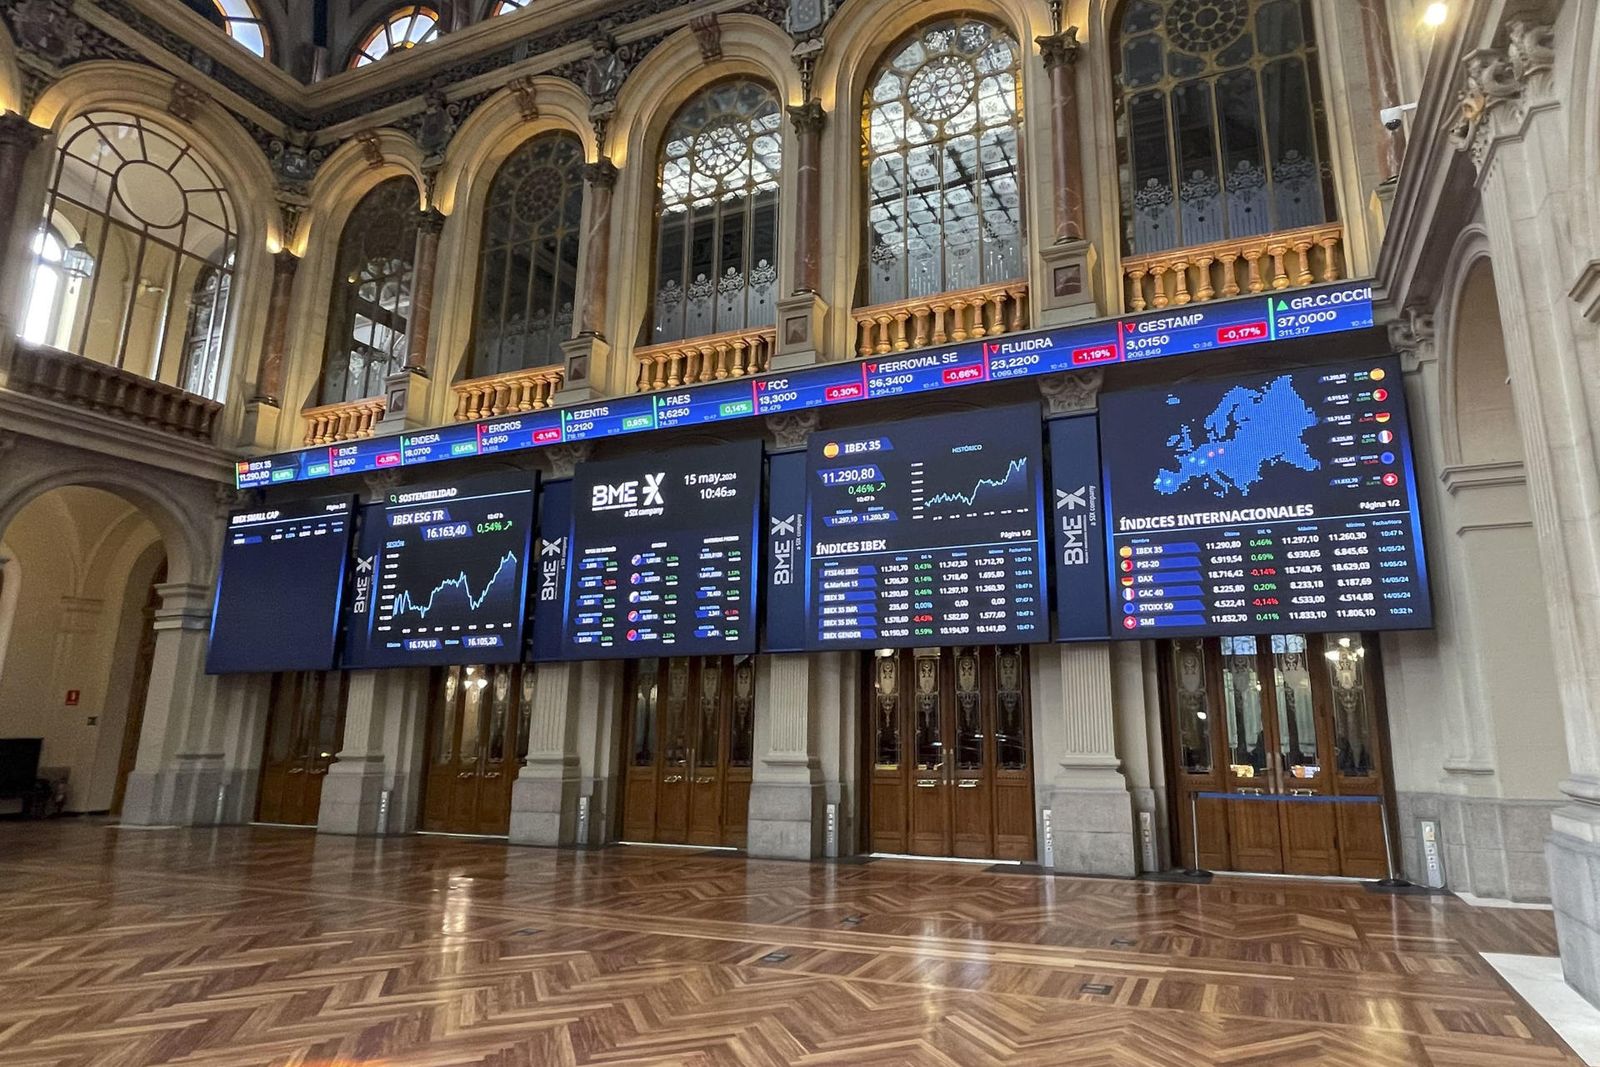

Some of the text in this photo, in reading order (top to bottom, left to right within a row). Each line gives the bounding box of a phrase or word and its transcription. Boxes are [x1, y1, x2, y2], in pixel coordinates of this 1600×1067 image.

[1138, 314, 1204, 333] GESTAMP
[1278, 310, 1337, 327] 37,0000
[1224, 327, 1260, 338] -0,17%
[1002, 338, 1053, 354] FLUIDRA
[1126, 335, 1170, 350] 3,0150
[1078, 350, 1110, 360] -1,19%
[879, 352, 958, 373] FERROVIAL SE
[991, 355, 1039, 370] 23,2200
[946, 368, 978, 380] -0,66%
[768, 380, 788, 390] FCC
[869, 374, 912, 388] 36,3400
[759, 392, 797, 404] 13,3000
[829, 387, 858, 398] -0,30%
[667, 395, 690, 406] FAES
[574, 407, 608, 420] EZENTIS
[659, 408, 690, 419] 3,6250
[725, 404, 746, 413] 0,14%
[489, 421, 520, 433] ERCROS
[567, 422, 593, 433] 0,2120
[410, 434, 440, 446] ENDESA
[482, 436, 508, 445] 3,4950
[339, 447, 357, 456] ENCE
[844, 440, 880, 454] IBEX 35
[684, 474, 696, 485] 15
[822, 468, 874, 484] 11.290,80
[592, 481, 638, 506] BME
[848, 484, 874, 494] 0,46%
[399, 488, 456, 502] SOSTENIBILIDAD
[1360, 502, 1386, 510] Página
[393, 510, 444, 526] IBEX ESG TR
[1120, 504, 1314, 530] ÍNDICES INTERNACIONALES
[427, 525, 466, 538] 16.163,40
[477, 522, 501, 533] 0,54%
[1063, 515, 1083, 565] BME
[1282, 535, 1319, 544] 11.297,10
[1328, 532, 1366, 542] 11.260,30
[816, 540, 886, 555] ÍNDICES IBEX
[1206, 541, 1241, 550] 11.290,80
[1250, 539, 1272, 547] 0,46%
[1287, 550, 1320, 559] 6.930,65
[1334, 547, 1368, 556] 6.845,65
[774, 540, 790, 584] BME
[975, 558, 1004, 566] 11.712,70
[1210, 556, 1242, 564] 6.919,54
[1250, 568, 1276, 576] -0,14%
[1332, 562, 1370, 572] 18.629,03
[1208, 570, 1243, 578] 18.716,42
[541, 560, 556, 600] BME
[1290, 580, 1324, 589] 8.233,18
[1338, 578, 1372, 586] 8.187,69
[1214, 584, 1244, 593] 8.225,80
[354, 578, 368, 613] BME
[1292, 596, 1325, 604] 4.533,00
[1214, 600, 1245, 608] 4.522,41
[1253, 598, 1278, 606] -0,14%
[1140, 618, 1154, 626] SMI
